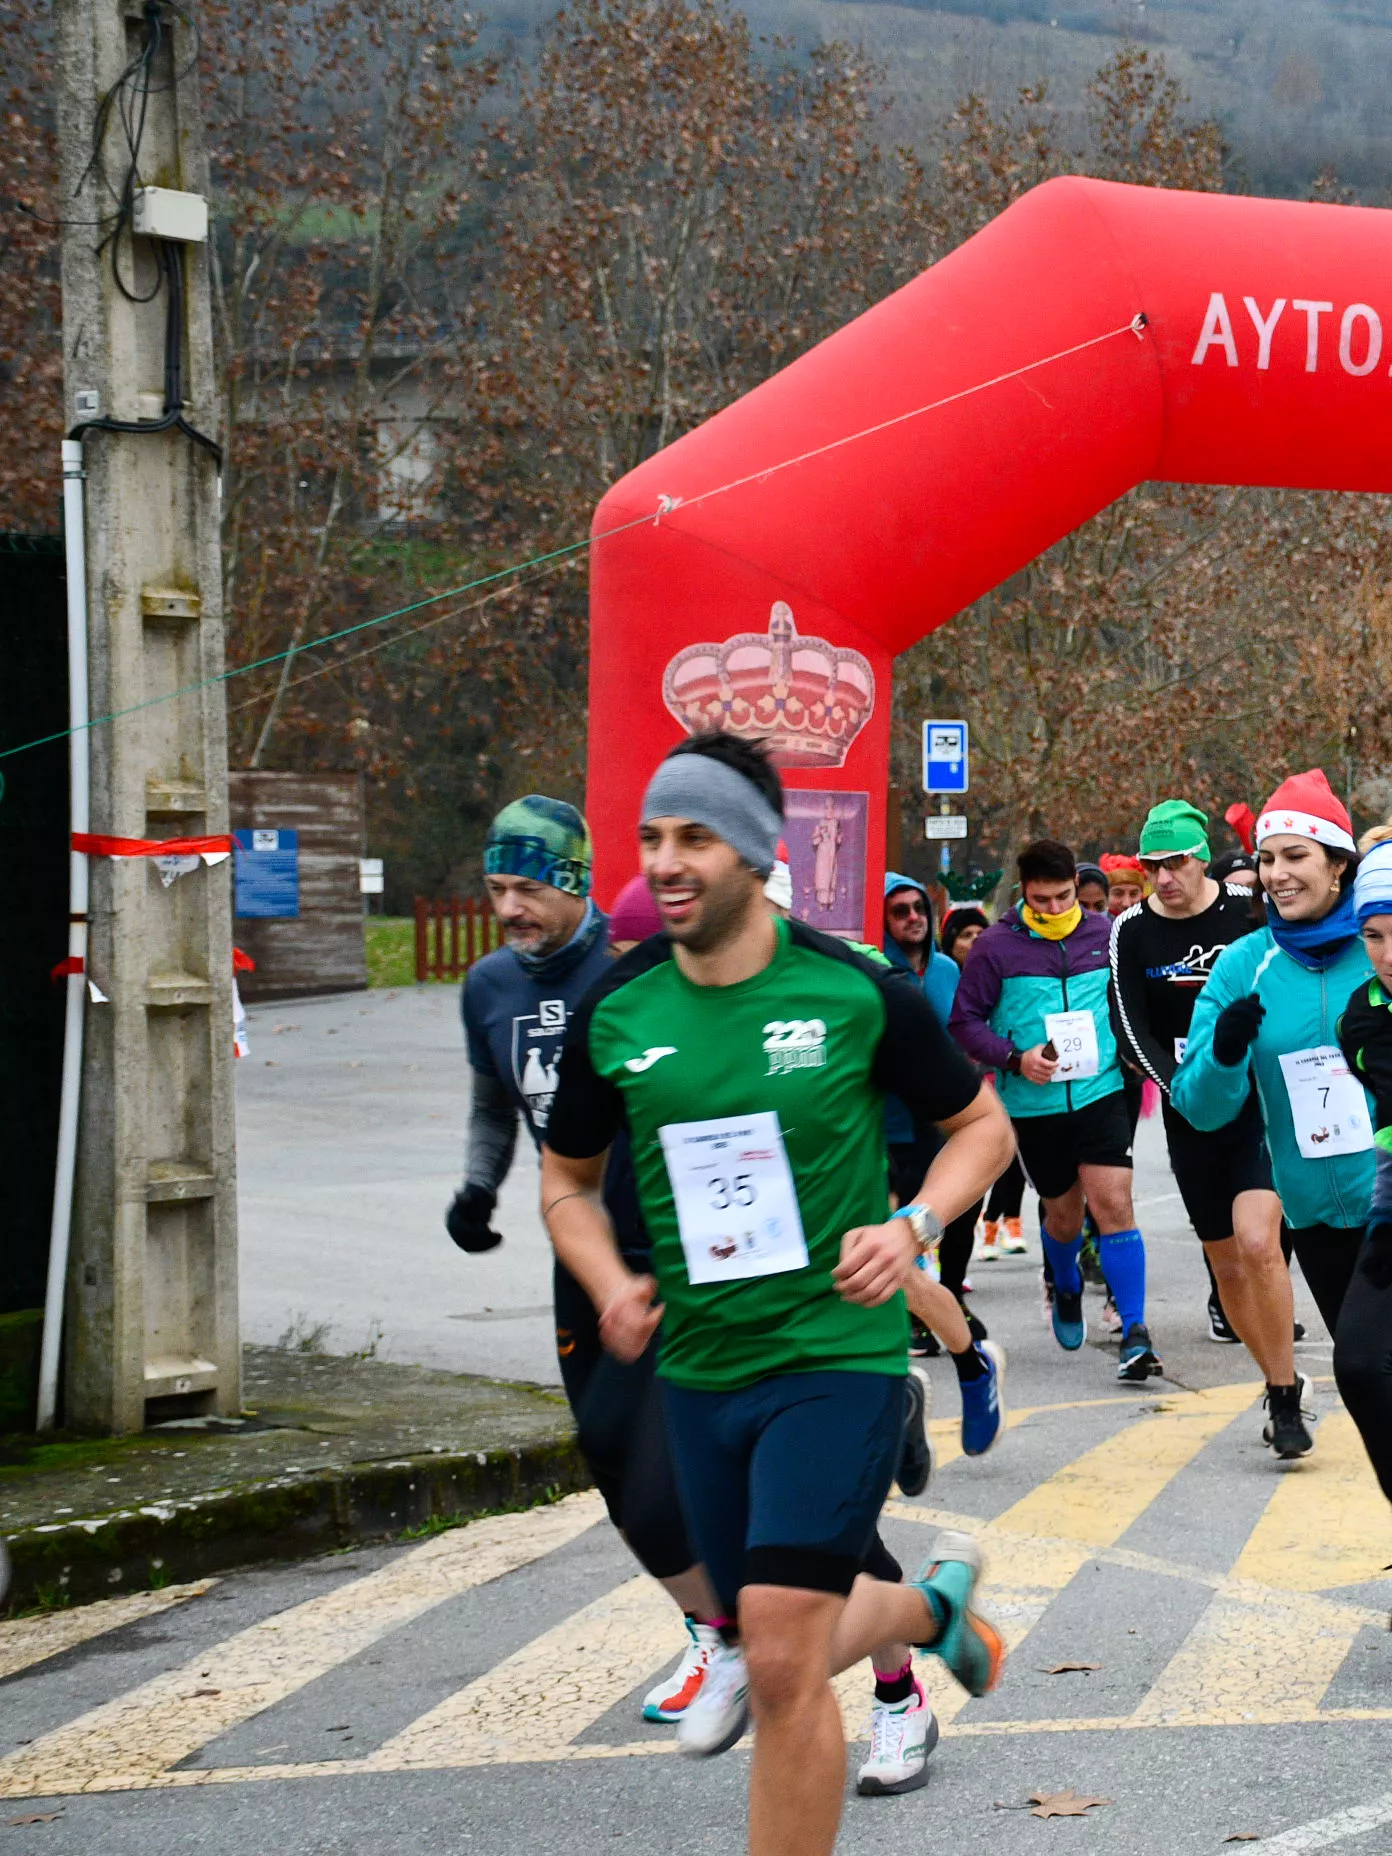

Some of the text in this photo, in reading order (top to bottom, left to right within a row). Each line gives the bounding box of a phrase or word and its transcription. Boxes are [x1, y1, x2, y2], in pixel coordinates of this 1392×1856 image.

[543, 1002, 563, 1024] S
[1062, 1036, 1083, 1053] 29
[1317, 1087, 1330, 1109] 7
[707, 1173, 757, 1211] 35
